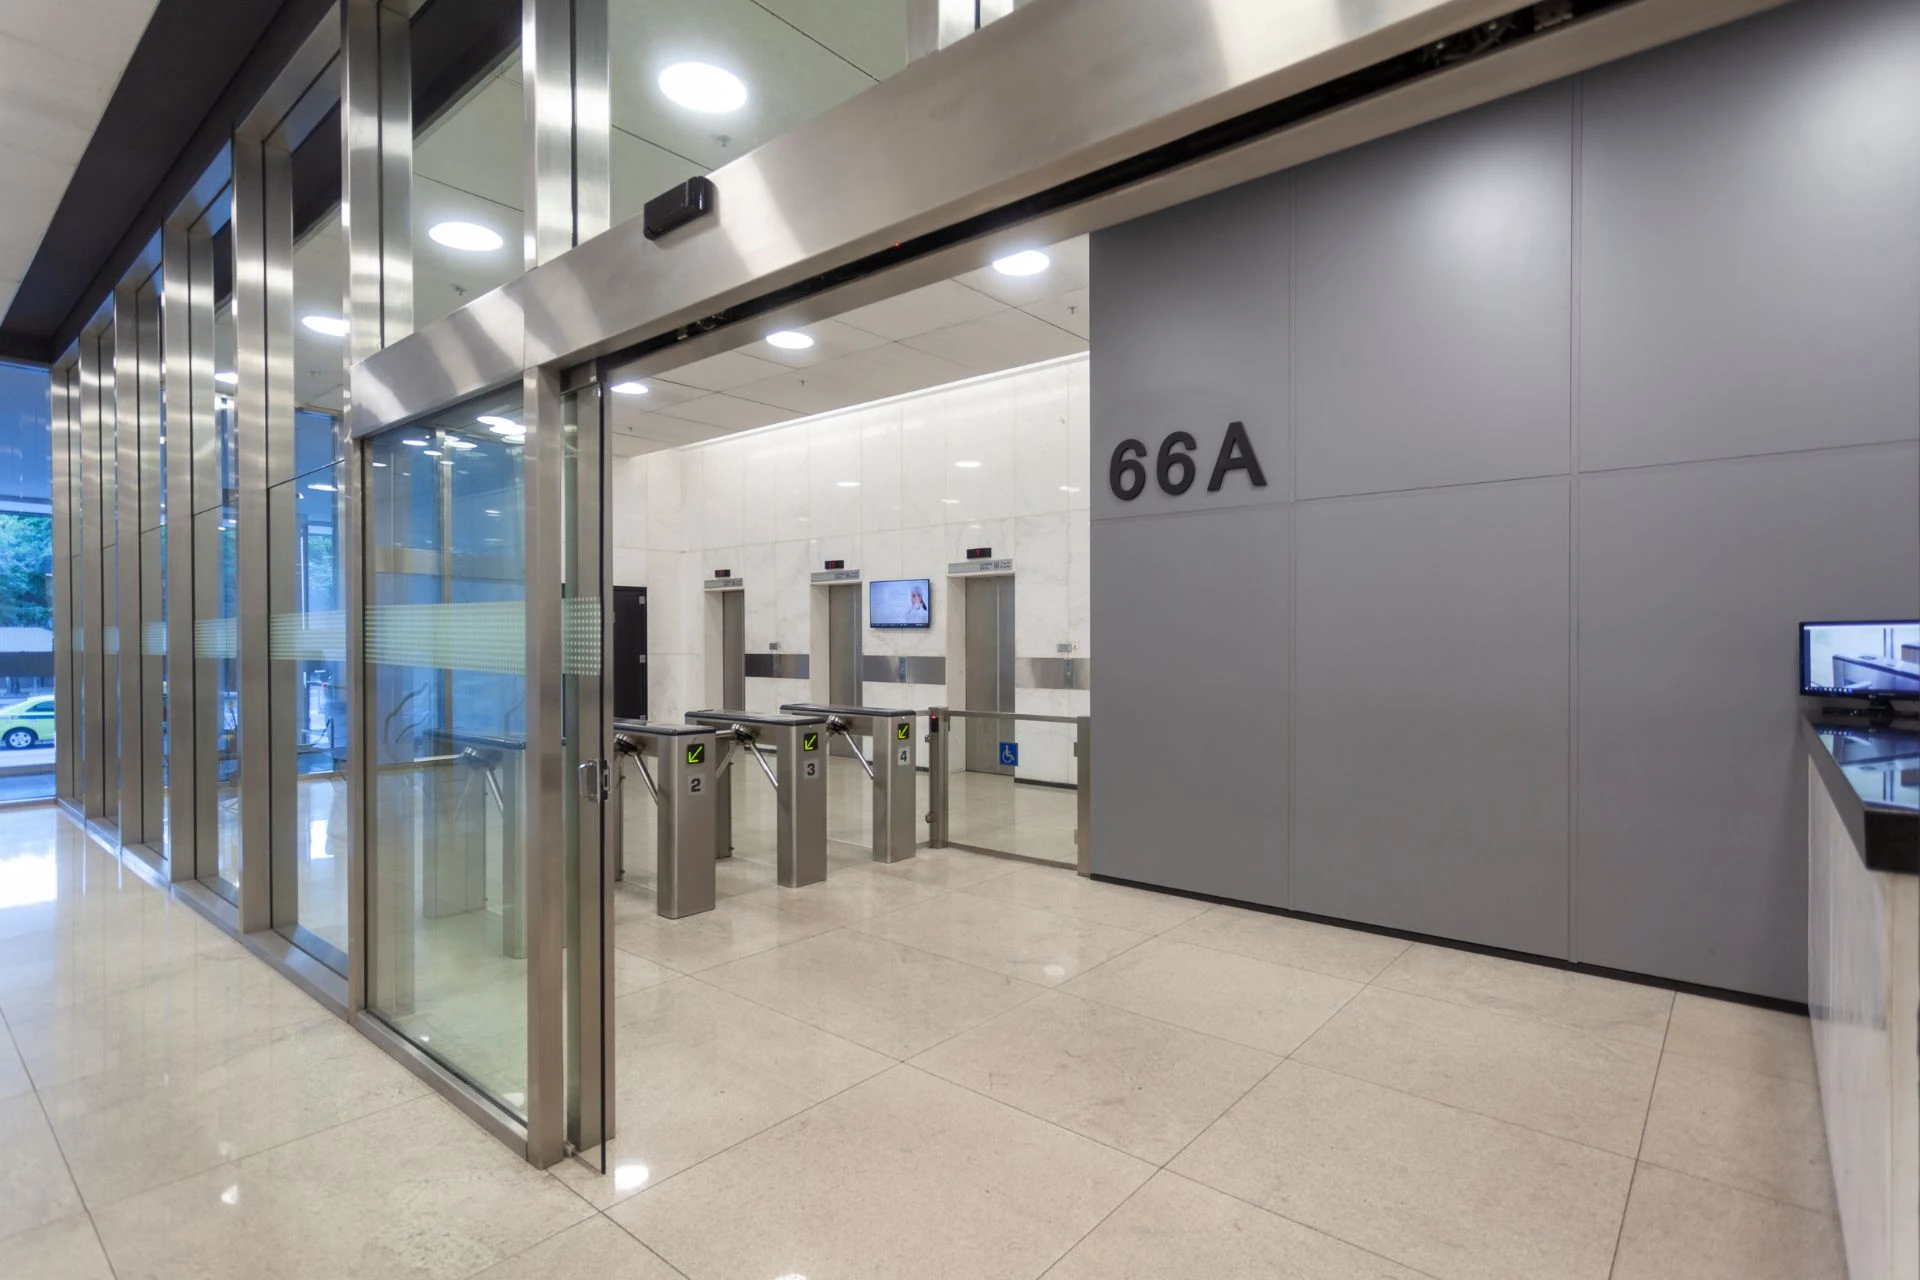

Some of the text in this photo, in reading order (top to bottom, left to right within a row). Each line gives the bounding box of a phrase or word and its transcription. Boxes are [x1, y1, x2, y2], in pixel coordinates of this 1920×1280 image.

[1109, 421, 1268, 501] 66A
[900, 750, 907, 762] 4
[807, 763, 815, 776] 3
[691, 778, 701, 792] 2
